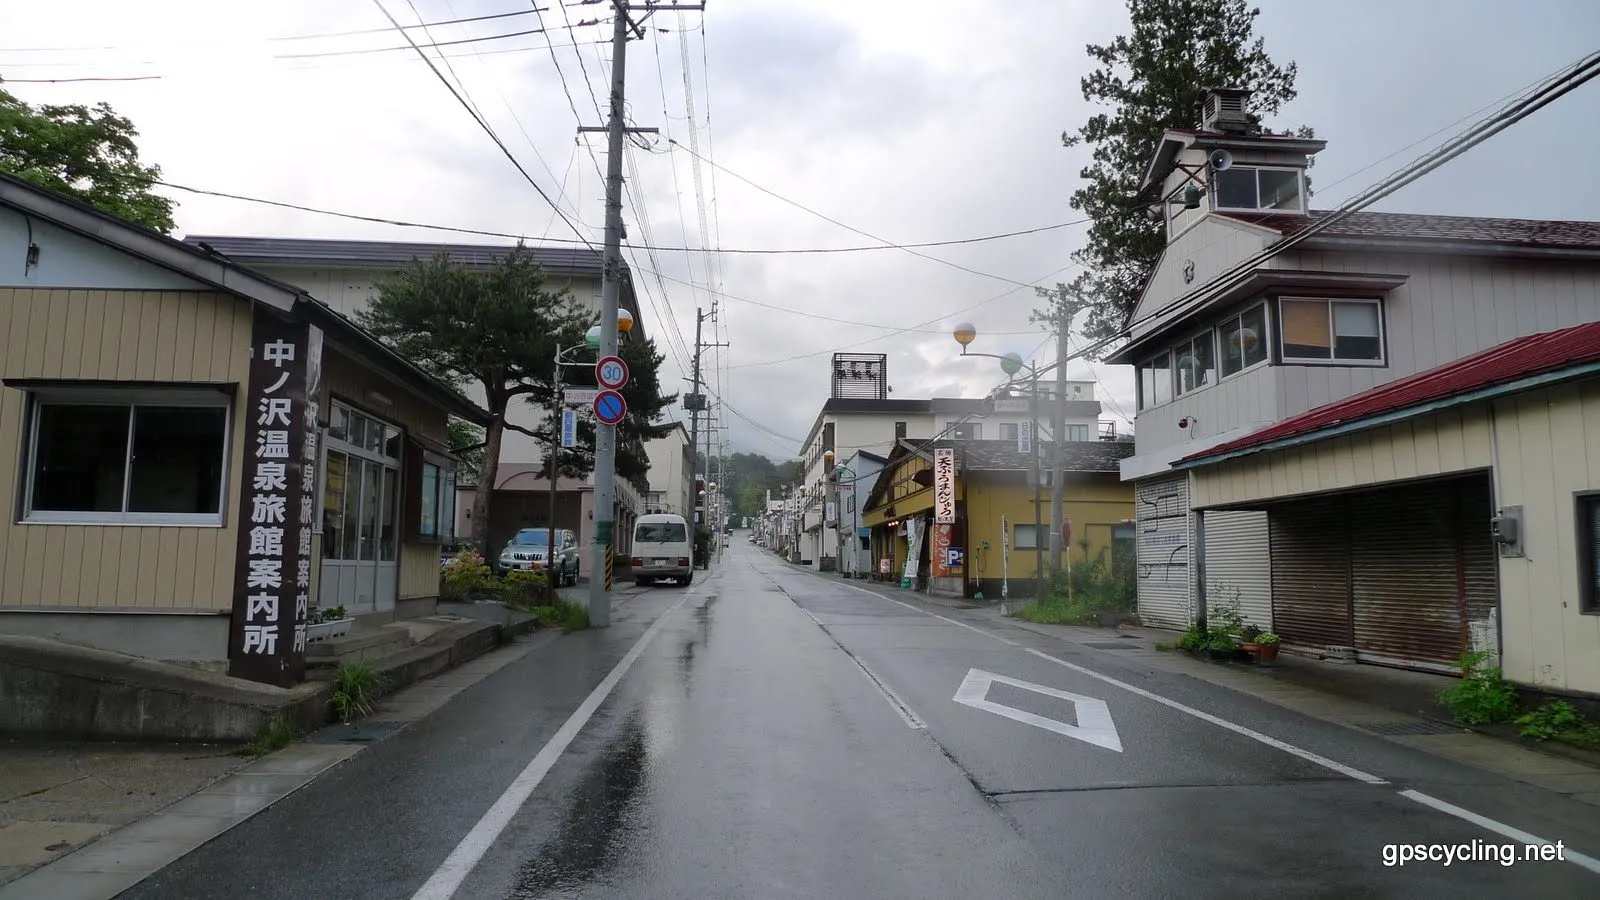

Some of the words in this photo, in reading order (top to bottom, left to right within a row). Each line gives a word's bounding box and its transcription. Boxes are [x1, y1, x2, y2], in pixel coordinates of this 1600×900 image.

[603, 366, 621, 381] 30
[243, 339, 296, 655] 中ノ沢温泉旅館案内所
[948, 550, 959, 565] P
